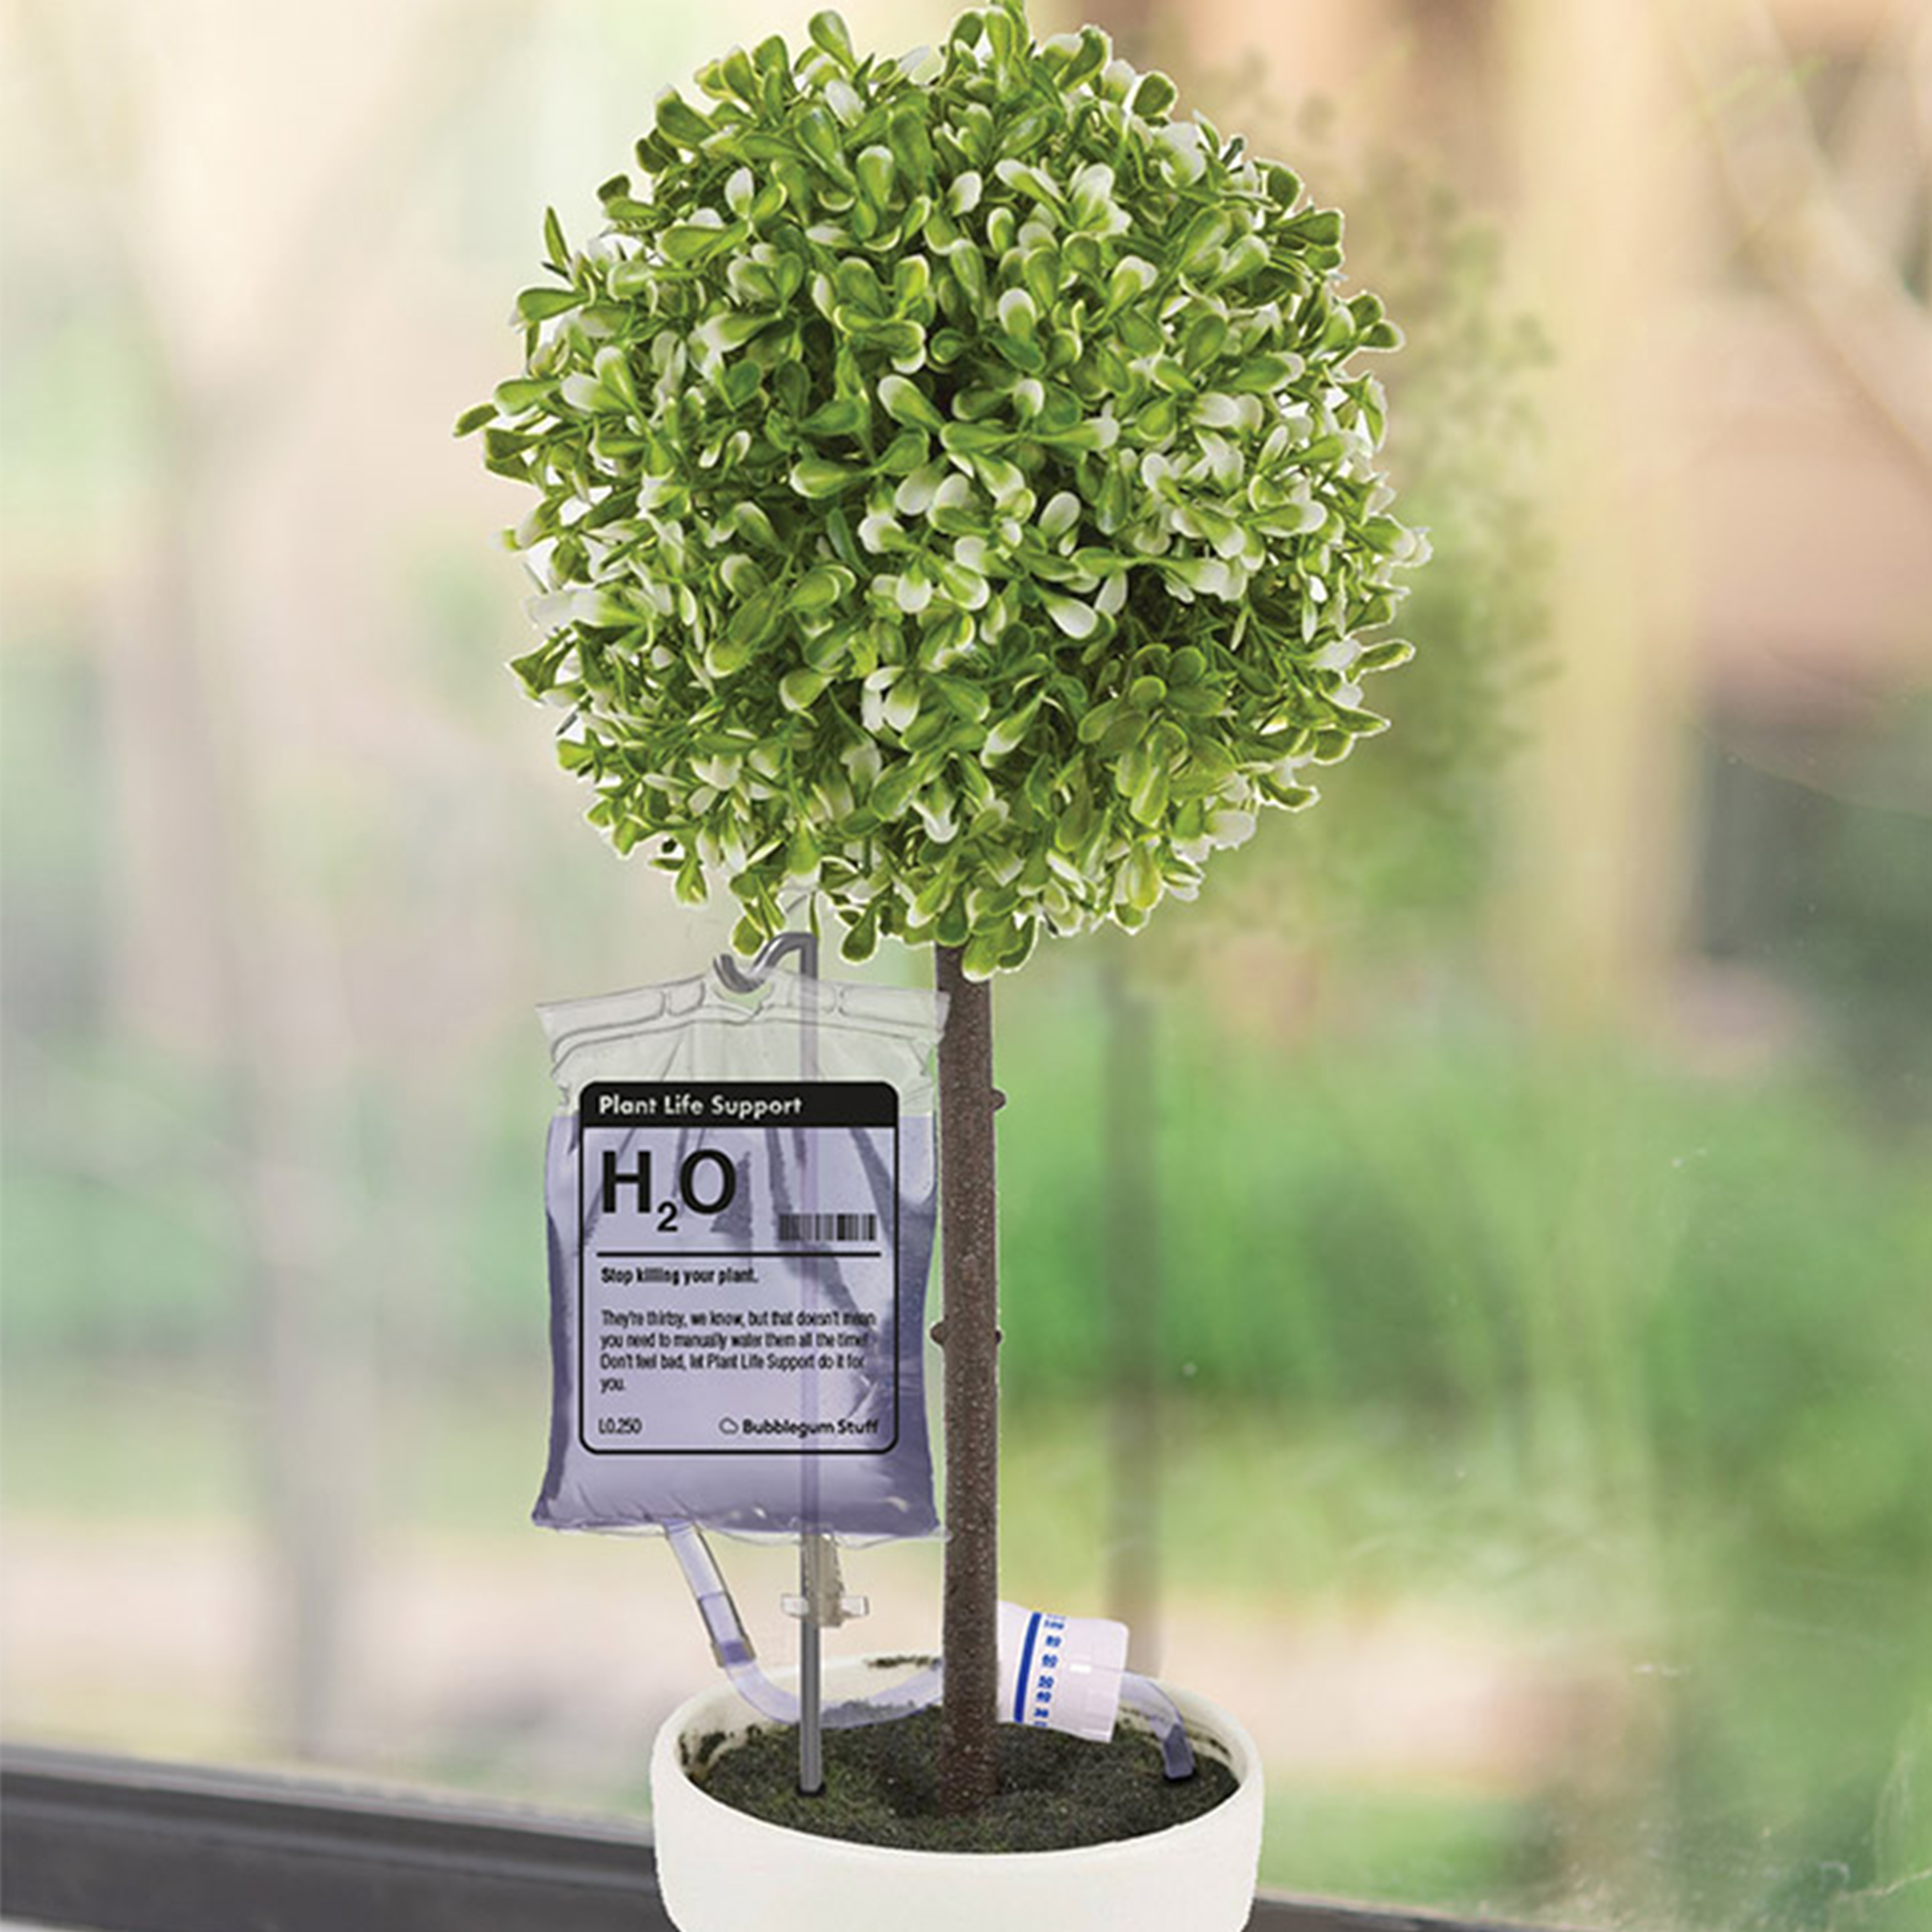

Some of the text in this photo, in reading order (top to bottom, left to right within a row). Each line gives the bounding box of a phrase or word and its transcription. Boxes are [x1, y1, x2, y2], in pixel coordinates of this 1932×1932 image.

[600, 1094, 801, 1119] Plant Life Support
[601, 1267, 758, 1286] Stop killing your plant.
[690, 1313, 707, 1326] we
[710, 1311, 745, 1327] know,
[748, 1311, 768, 1326] but
[771, 1311, 794, 1326] that
[797, 1311, 839, 1326] doesn't
[842, 1312, 876, 1327] mean
[600, 1335, 623, 1350] you
[626, 1333, 655, 1348] need
[658, 1333, 672, 1348] to
[673, 1333, 727, 1350] manually
[731, 1333, 762, 1348] water
[765, 1333, 796, 1348] them
[799, 1332, 812, 1348] all
[816, 1333, 835, 1348] the
[600, 1352, 865, 1372] Don't feel bad, let Plant Life Support do it for
[742, 1419, 879, 1438] Bubblegum Stuff
